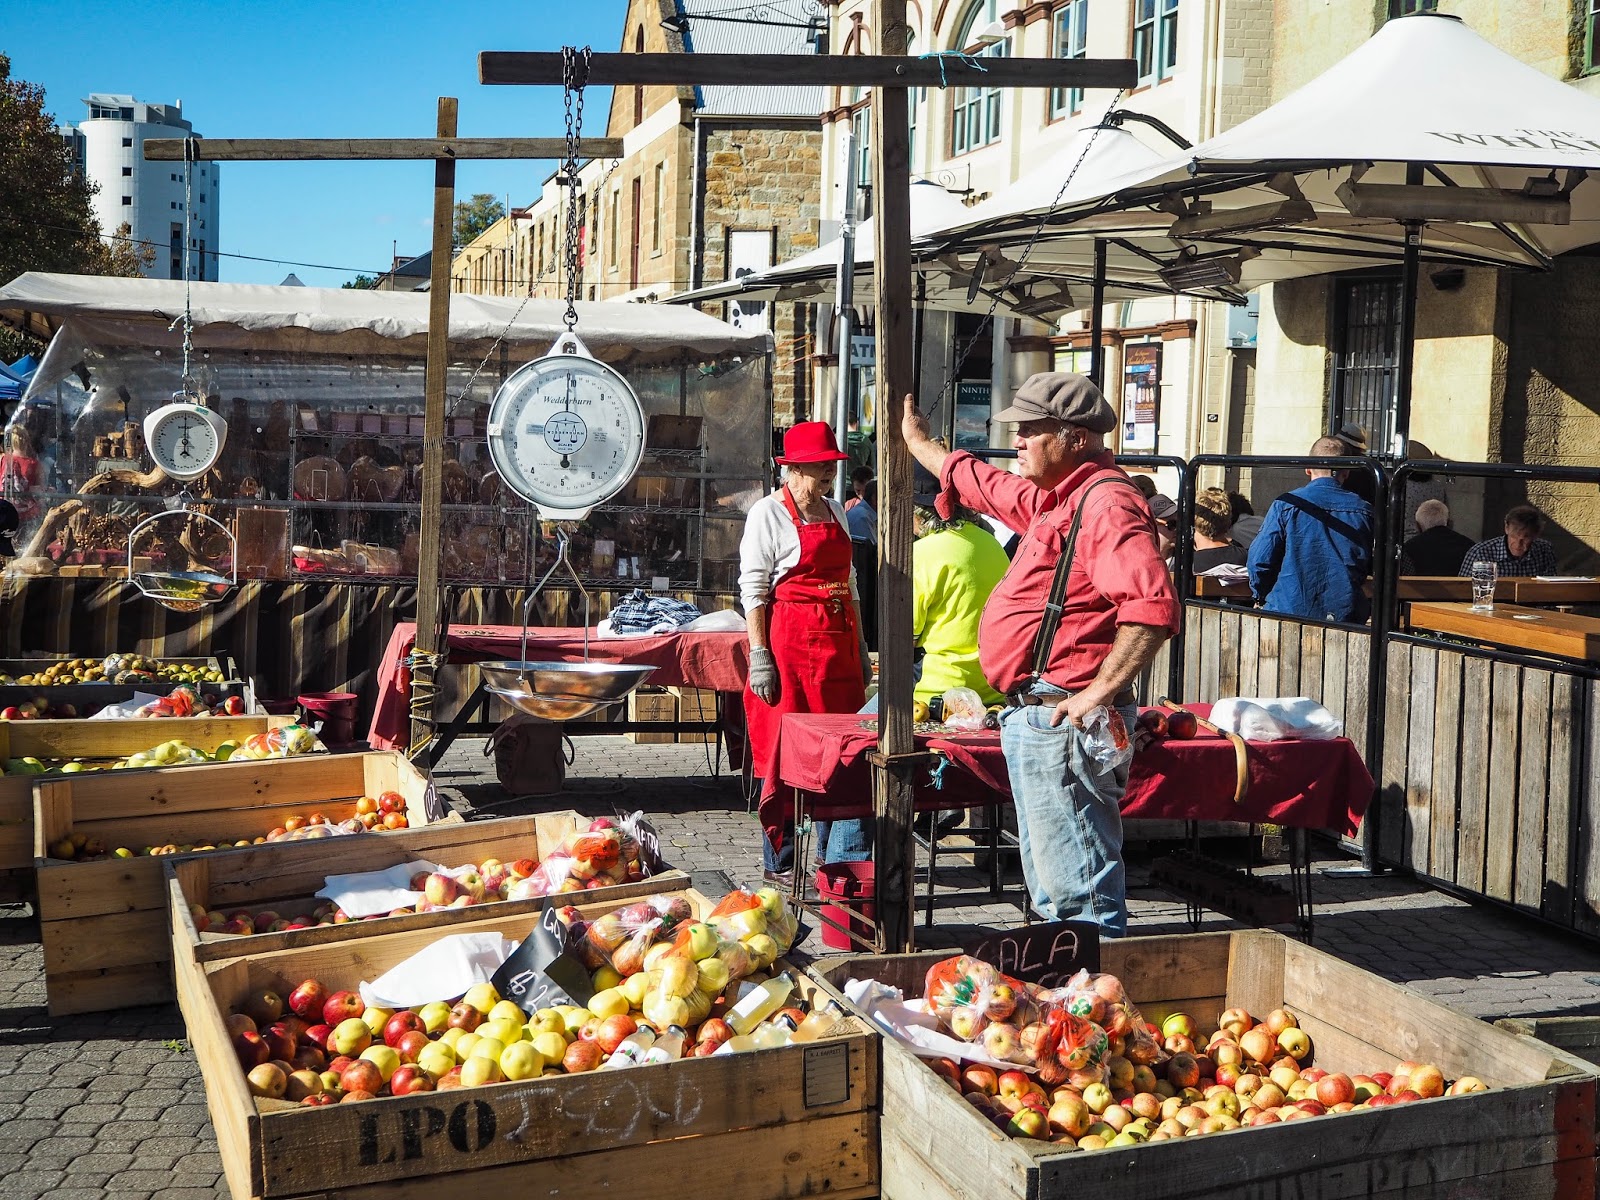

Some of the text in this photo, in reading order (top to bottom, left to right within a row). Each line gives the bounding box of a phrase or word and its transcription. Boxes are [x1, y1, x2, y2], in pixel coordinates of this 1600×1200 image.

[570, 379, 577, 388] 10
[543, 396, 592, 406] Wedderburn
[560, 478, 565, 487] 5
[358, 1099, 497, 1167] LPO
